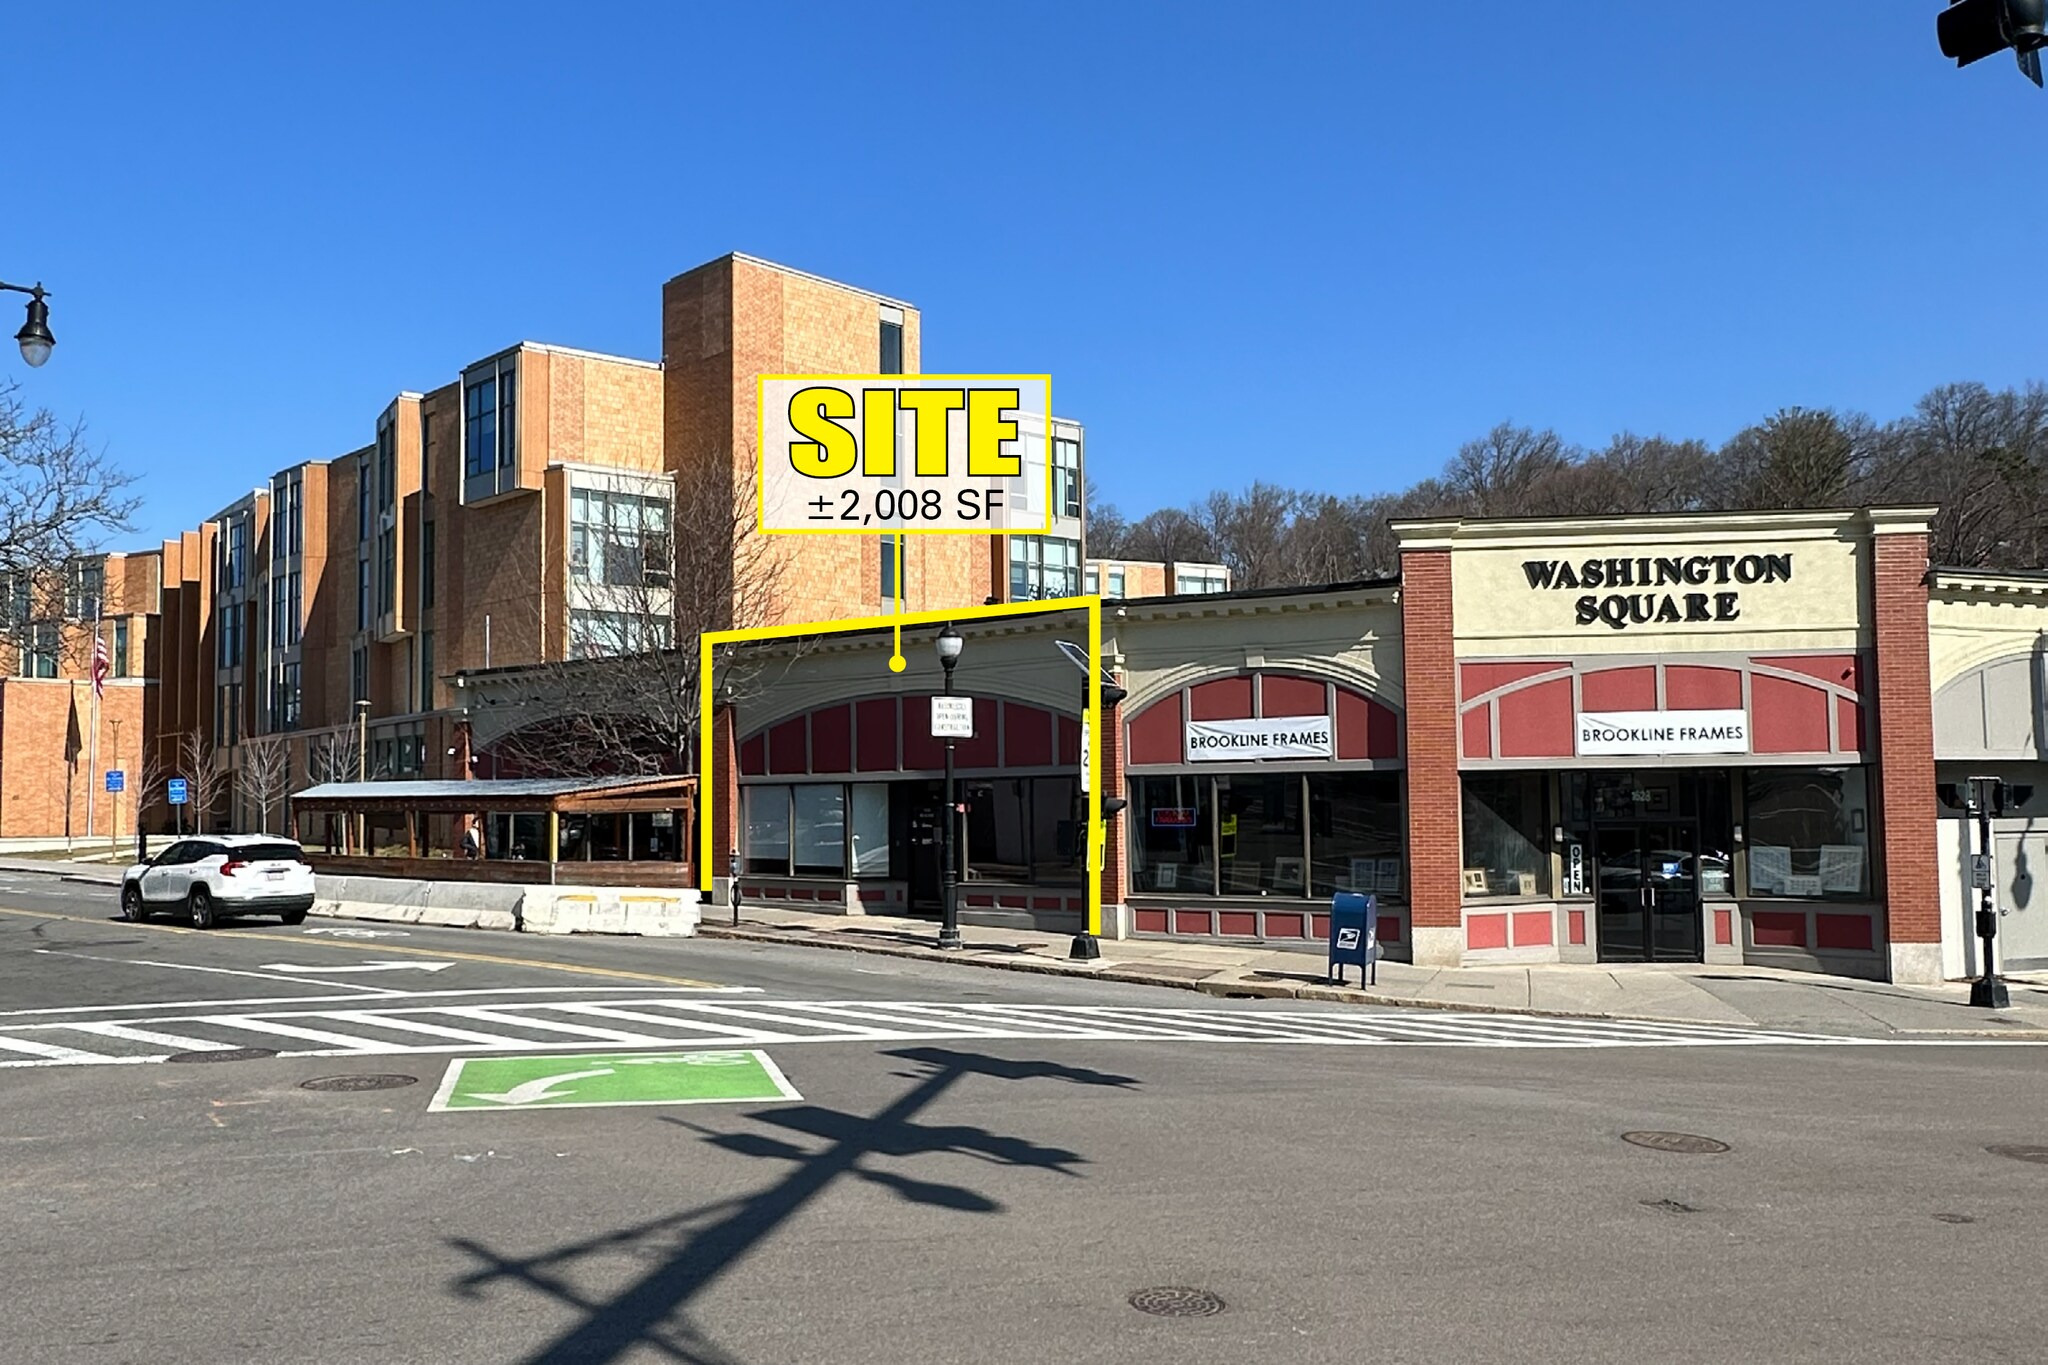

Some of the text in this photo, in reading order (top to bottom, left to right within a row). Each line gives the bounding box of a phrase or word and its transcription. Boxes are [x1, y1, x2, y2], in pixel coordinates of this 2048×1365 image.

[1521, 553, 1793, 590] WASHINGTON
[1575, 592, 1741, 630] SQUARE
[1190, 731, 1329, 749] BROOKLINE FRAMES
[1583, 726, 1743, 742] BROOKLINE FRAMES
[1573, 846, 1581, 891] OPEN
